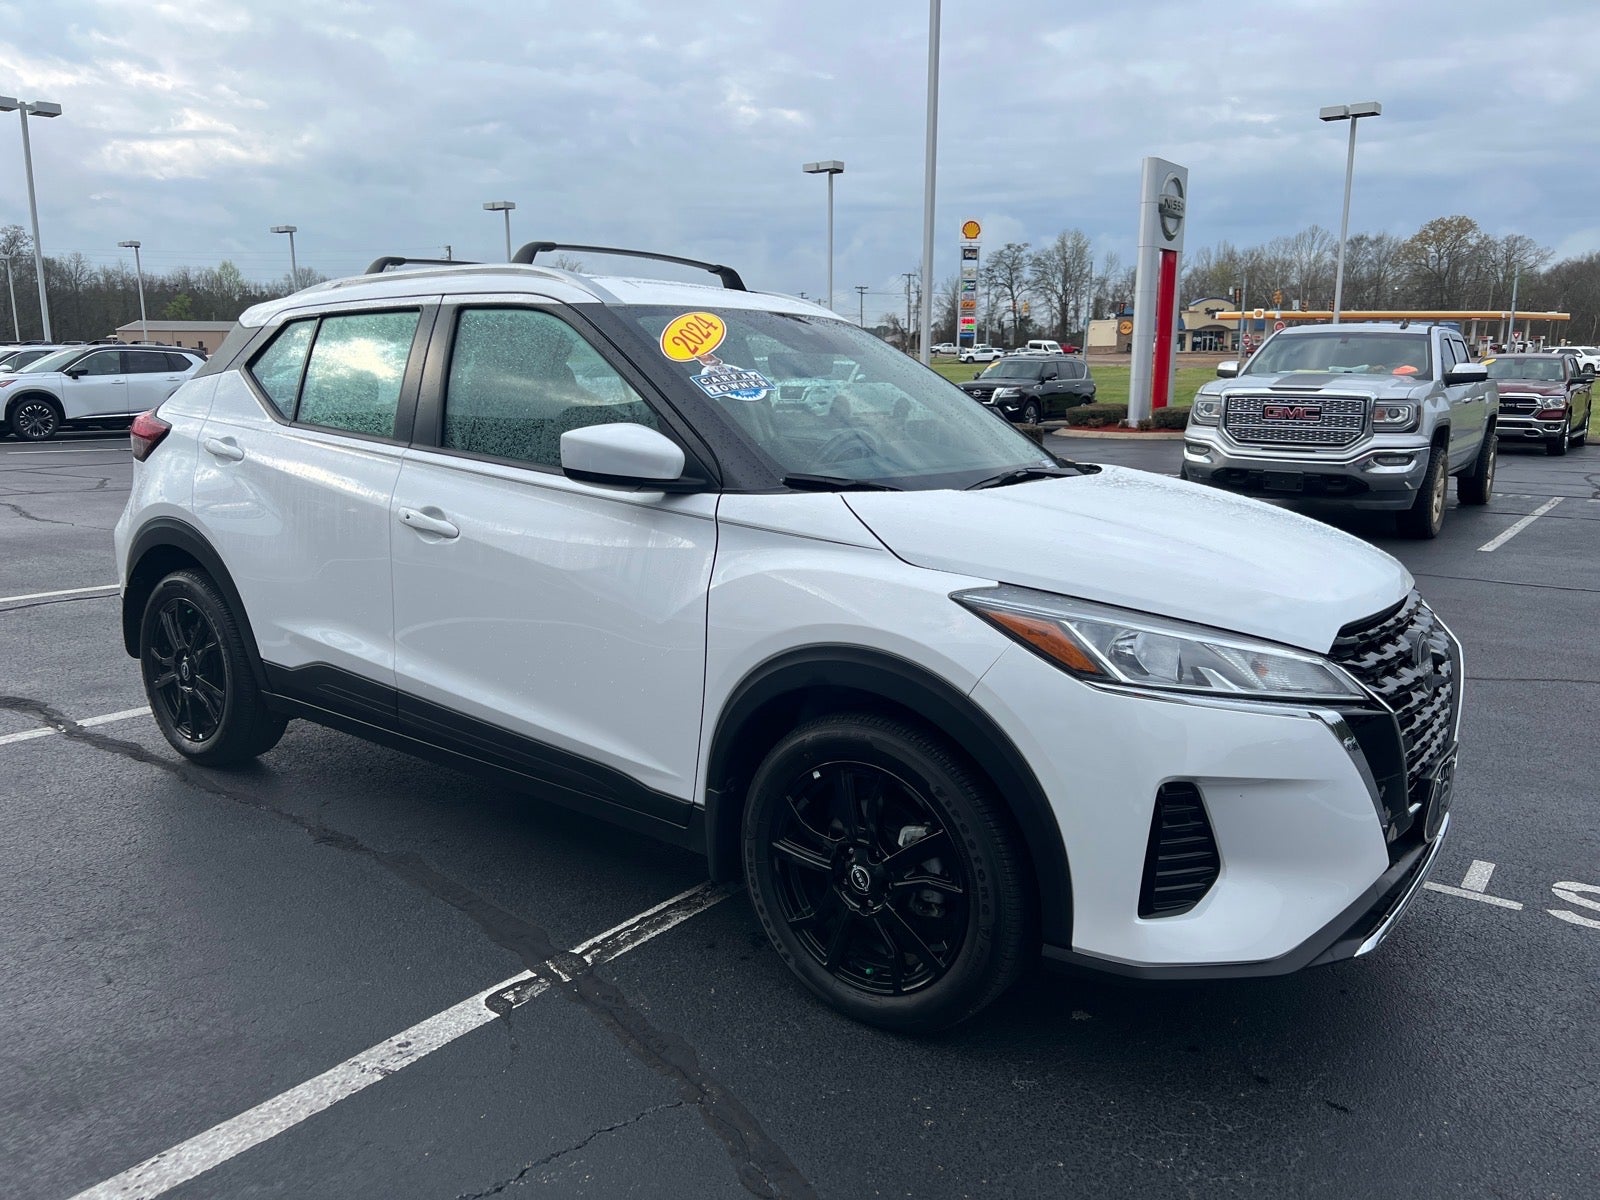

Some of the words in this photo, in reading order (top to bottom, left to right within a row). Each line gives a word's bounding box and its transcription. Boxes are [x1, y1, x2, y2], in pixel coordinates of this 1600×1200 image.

[672, 315, 719, 355] 2024
[699, 371, 762, 385] CARFAX
[720, 381, 768, 391] OWNER
[1264, 406, 1321, 420] GMC
